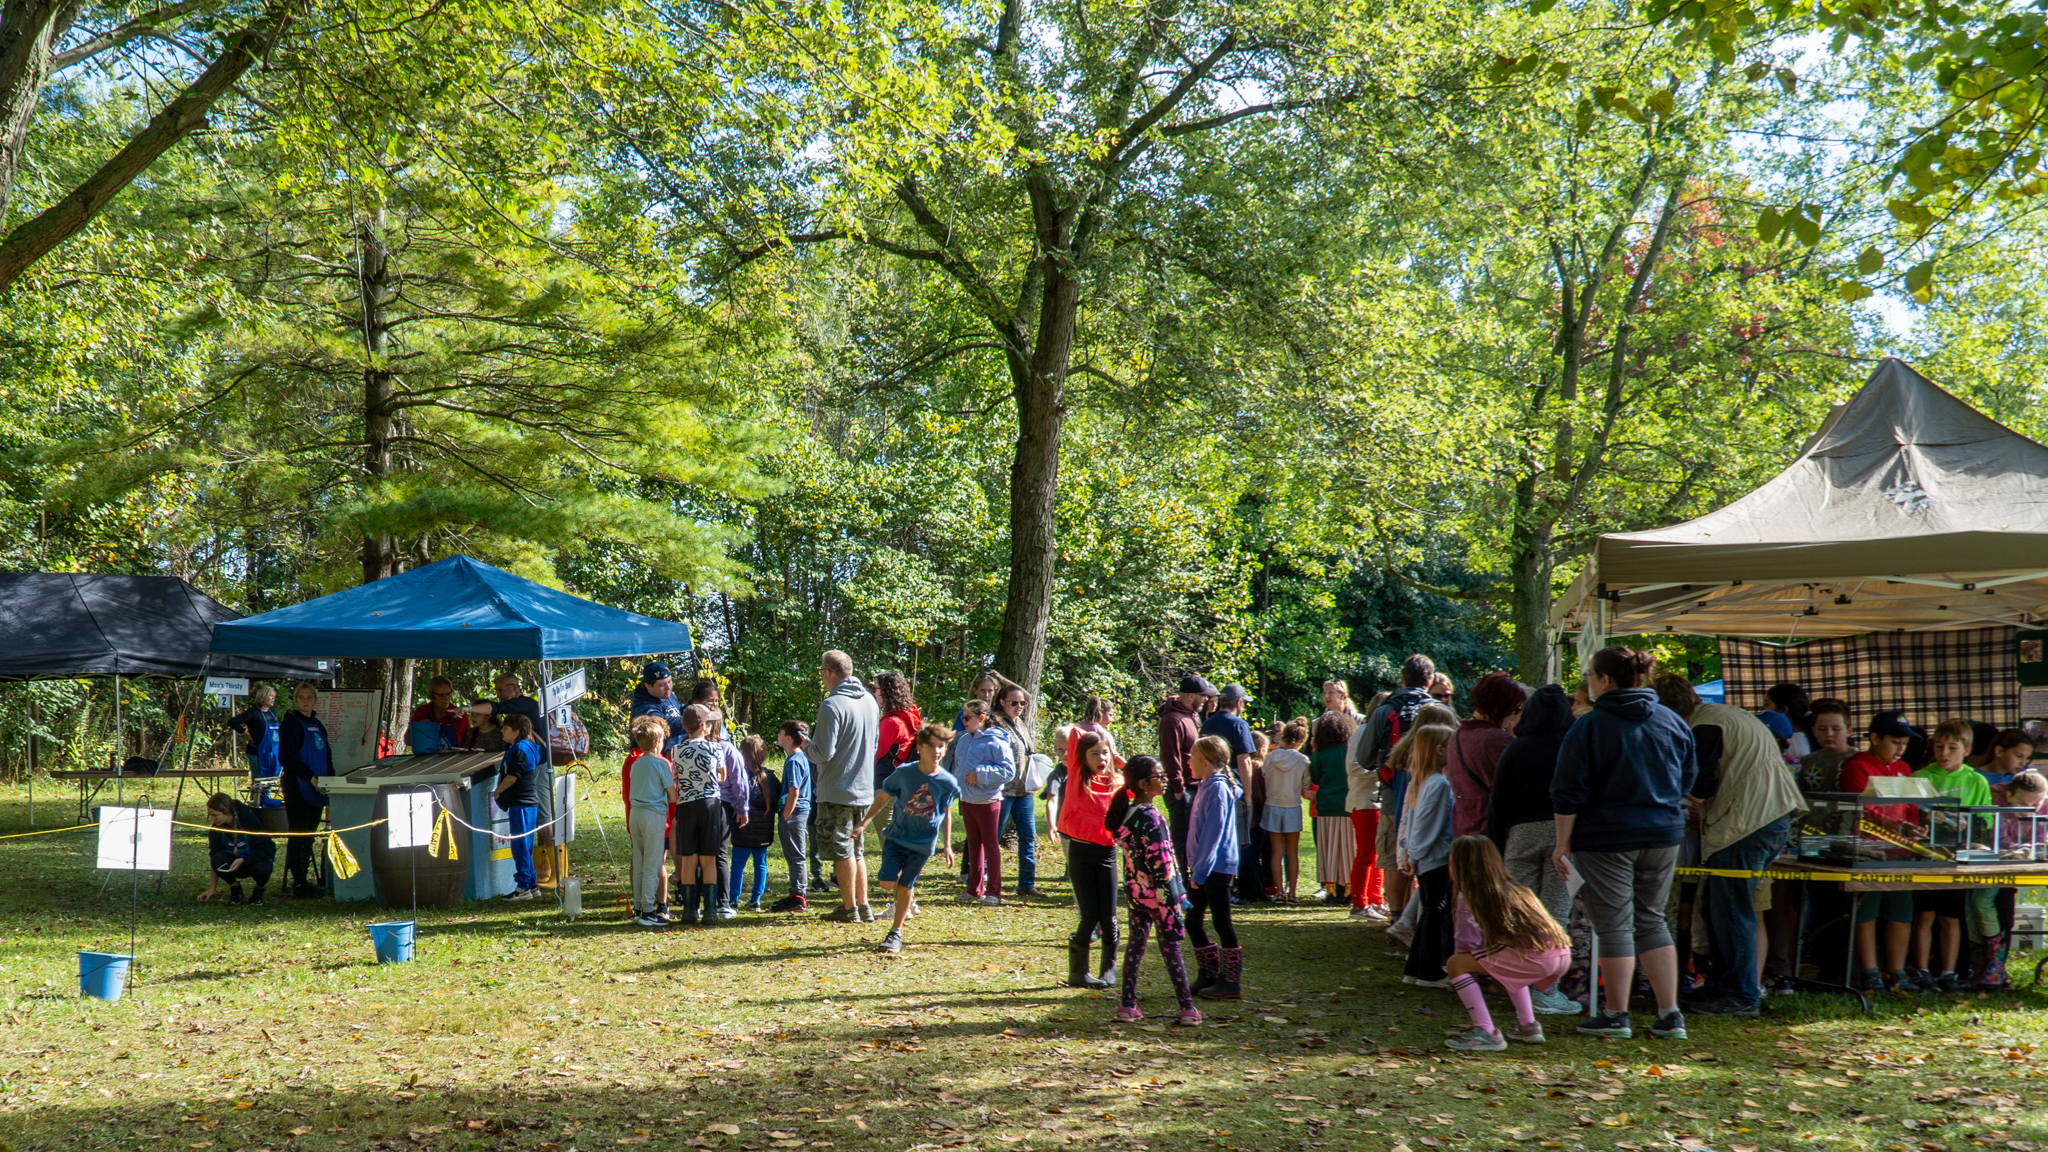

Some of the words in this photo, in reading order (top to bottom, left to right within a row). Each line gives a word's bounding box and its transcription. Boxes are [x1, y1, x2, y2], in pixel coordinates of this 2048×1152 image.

[225, 682, 243, 690] Thirsty
[222, 696, 227, 706] 2
[561, 708, 567, 724] 3
[1751, 871, 1811, 880] CAUTION
[1851, 874, 1912, 883] CAUTION
[1953, 876, 2015, 885] CAUTION
